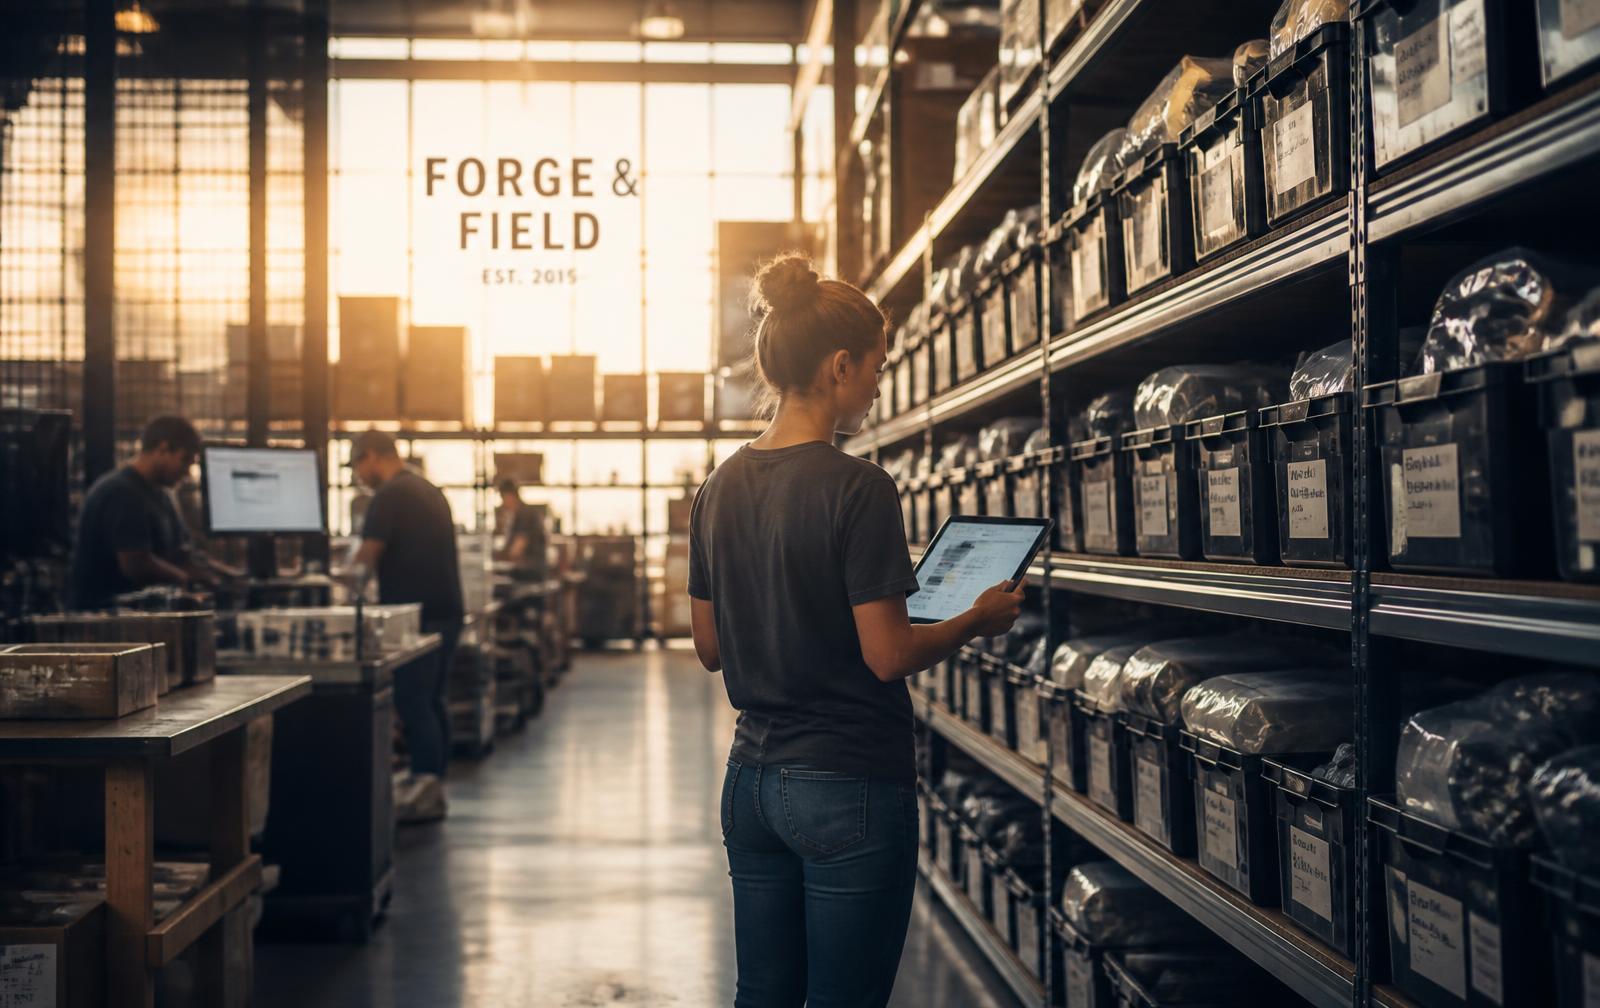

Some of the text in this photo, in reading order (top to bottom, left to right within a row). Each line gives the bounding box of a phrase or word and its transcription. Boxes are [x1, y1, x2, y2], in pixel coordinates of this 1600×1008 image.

[426, 157, 639, 197] FORGE &
[460, 212, 600, 250] FIELD
[482, 268, 578, 285] EST. 2015
